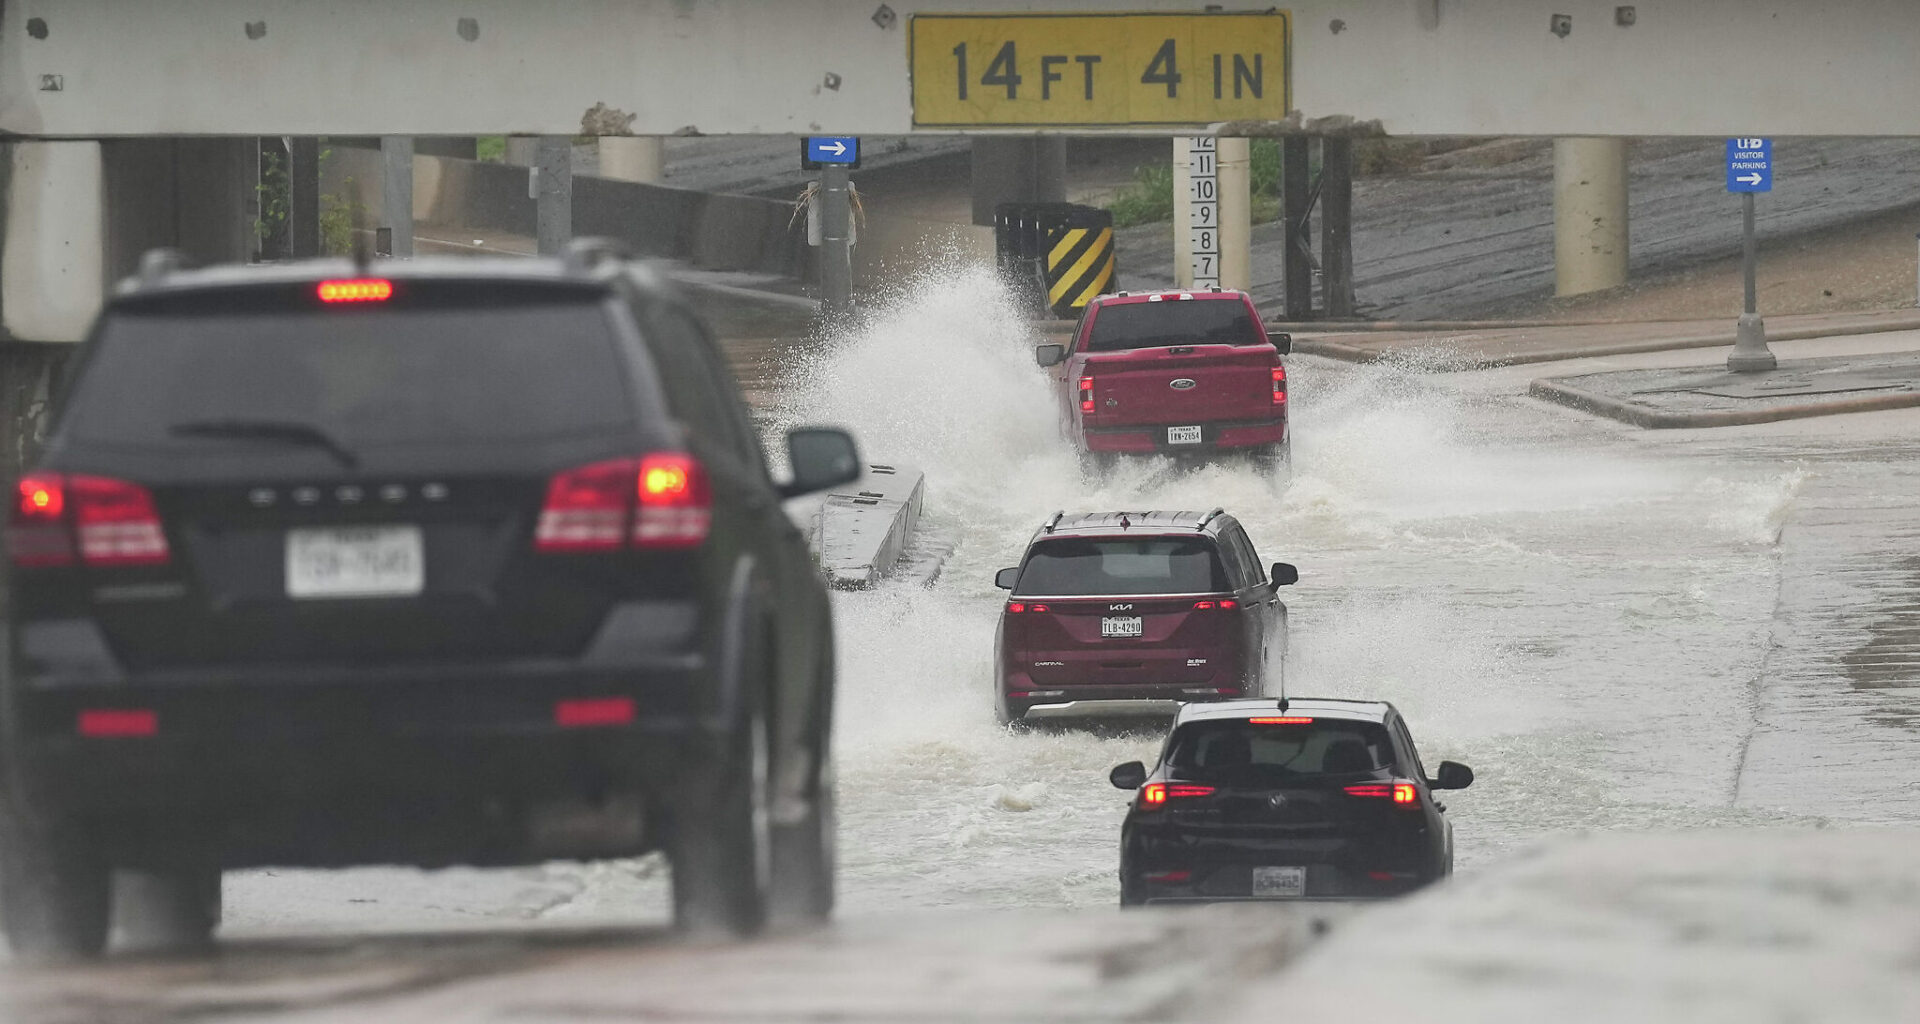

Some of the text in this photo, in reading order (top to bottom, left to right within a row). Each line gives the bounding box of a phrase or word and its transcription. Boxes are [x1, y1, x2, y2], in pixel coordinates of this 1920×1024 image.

[952, 38, 1262, 101] 14 FT 4 IN
[1199, 155, 1211, 173] 11
[1733, 151, 1764, 160] VISITOR
[1731, 162, 1767, 170] PARKING
[1196, 180, 1214, 199] 10
[1200, 206, 1211, 224] 9
[1201, 231, 1211, 250] 8
[1201, 257, 1212, 275] 7
